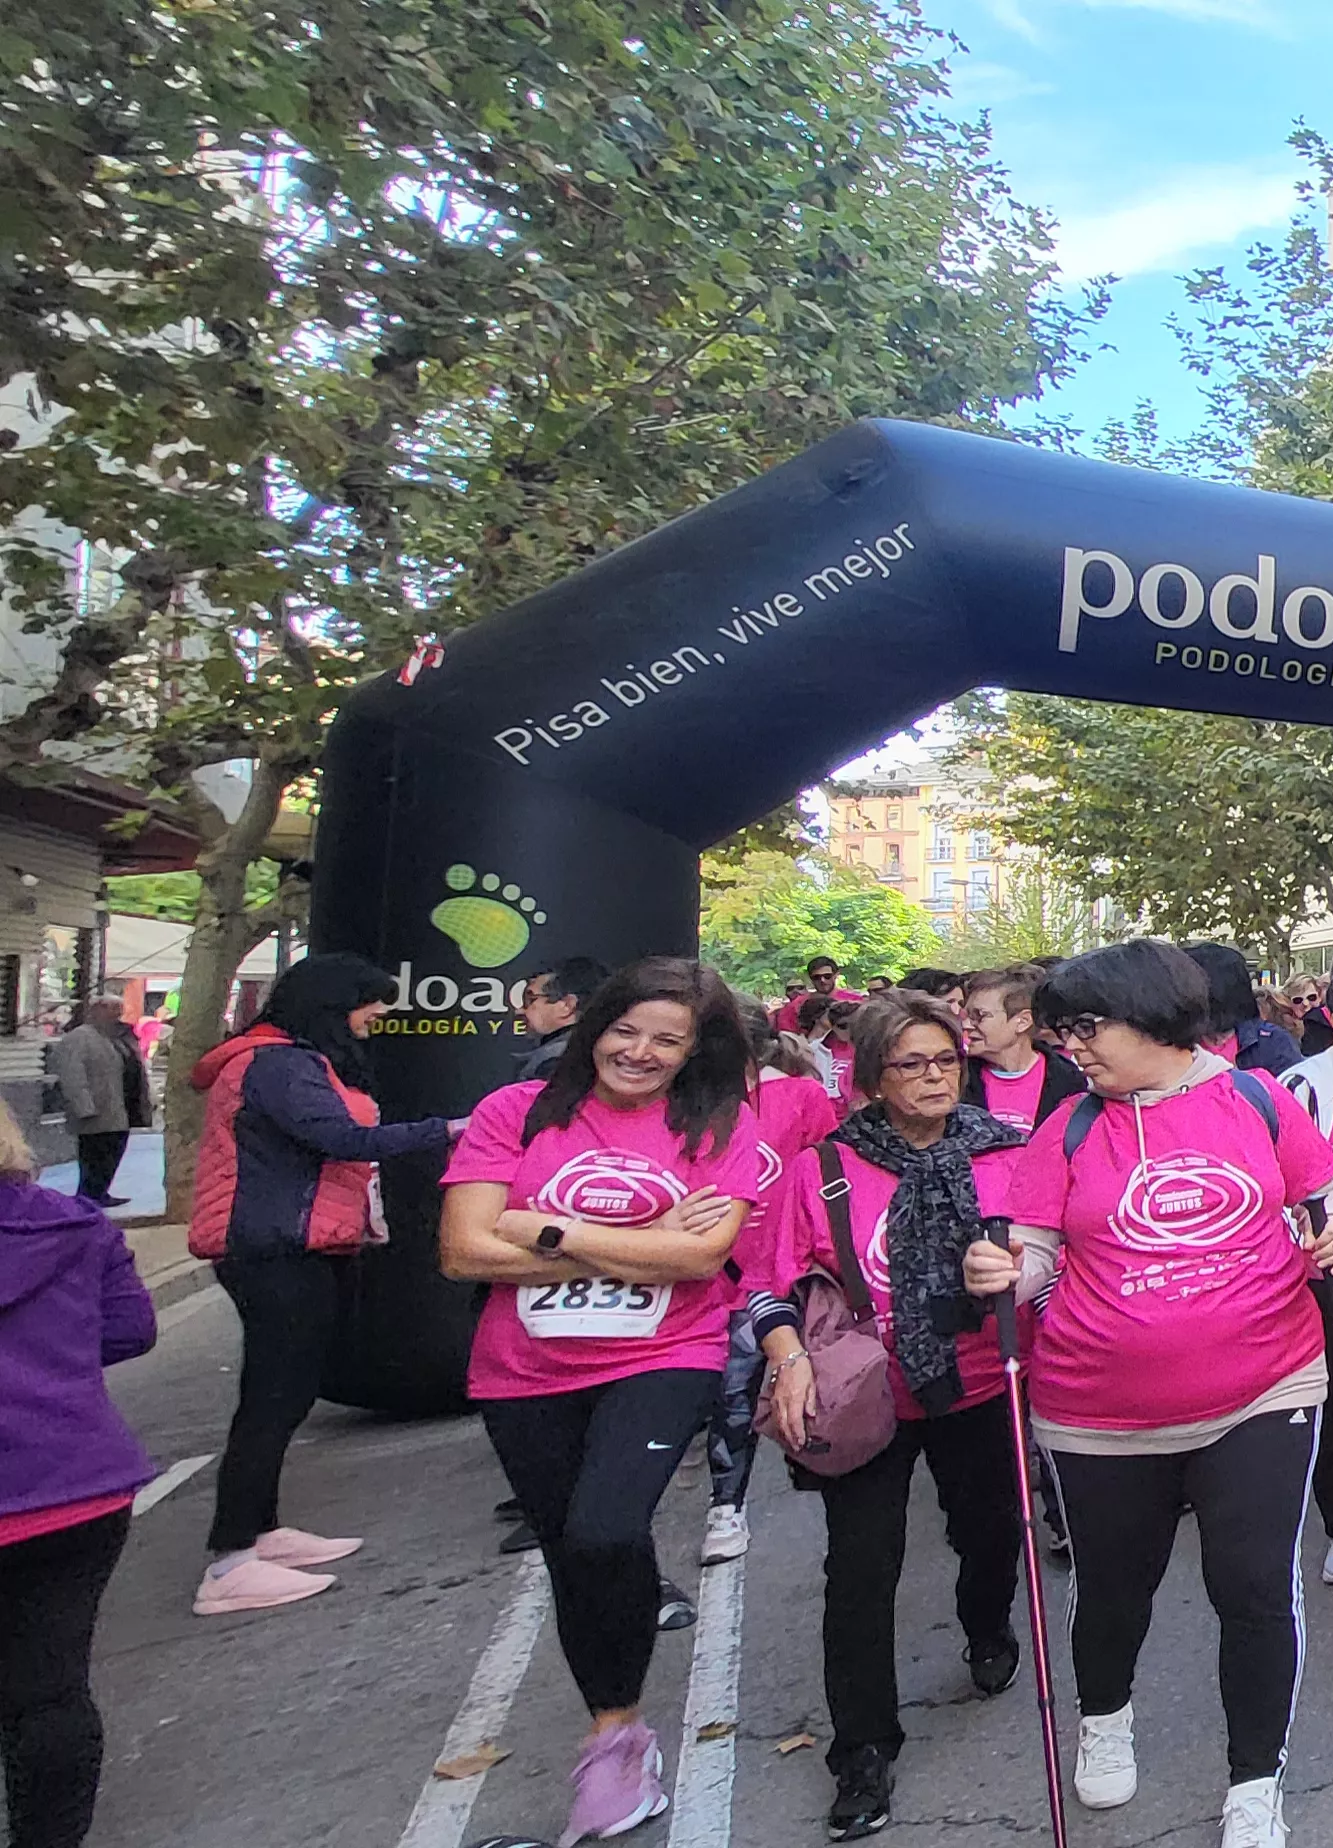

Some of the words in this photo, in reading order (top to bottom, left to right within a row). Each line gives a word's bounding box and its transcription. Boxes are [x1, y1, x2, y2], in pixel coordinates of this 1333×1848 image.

[493, 700, 611, 766] Pisa
[600, 645, 726, 709] bien,
[717, 592, 805, 646] vive
[804, 522, 917, 602] mejor
[488, 1019, 503, 1036] Y
[530, 1277, 656, 1311] 2835
